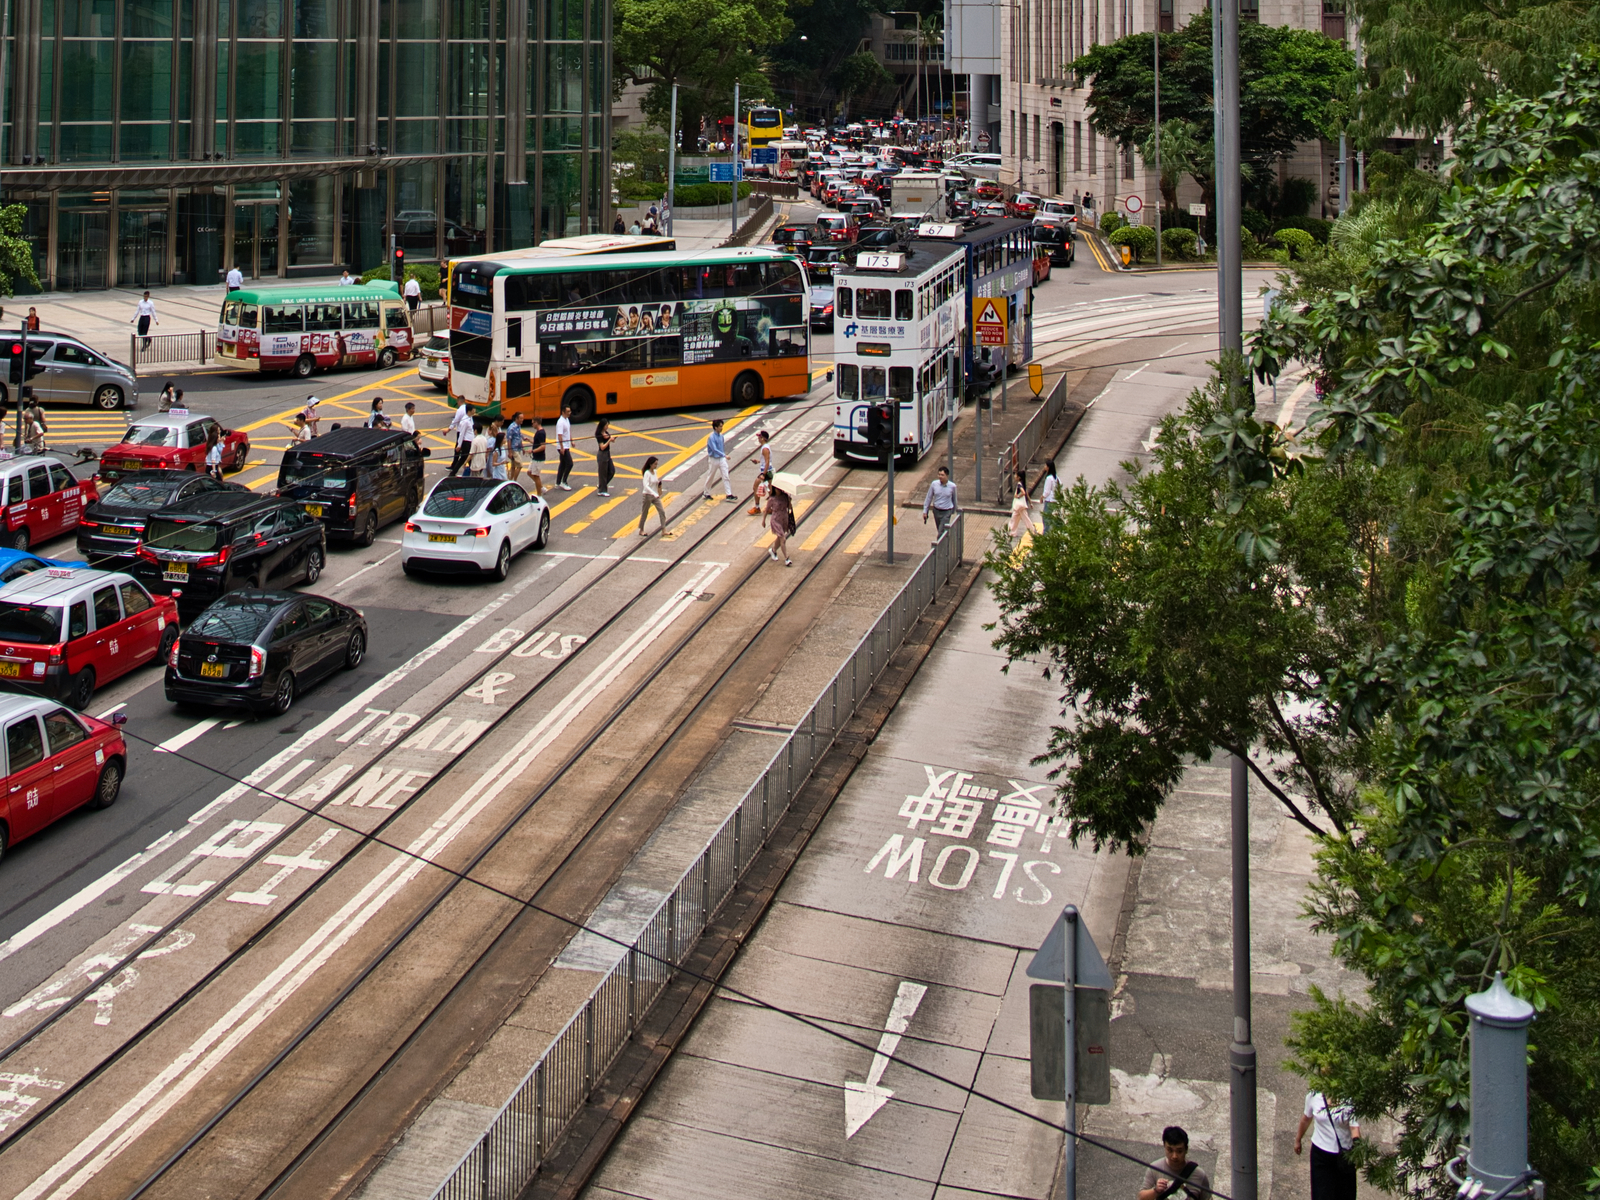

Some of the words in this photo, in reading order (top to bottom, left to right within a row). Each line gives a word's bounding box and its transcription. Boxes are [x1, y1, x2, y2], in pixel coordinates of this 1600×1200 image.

[928, 225, 944, 235] 67
[867, 256, 890, 267] 173
[861, 325, 905, 335] 基層醫療署
[654, 375, 677, 384] Citybus
[109, 639, 118, 648] 的士
[474, 628, 588, 660] BUS
[109, 645, 119, 656] TAXI
[463, 671, 516, 704] &
[336, 707, 492, 754] TRAM
[258, 759, 438, 810] LANE
[26, 787, 38, 800] 的士
[27, 797, 39, 810] TAXI
[141, 819, 341, 906] 巴士
[863, 833, 1062, 906] SLOW
[1, 922, 196, 1026] 及
